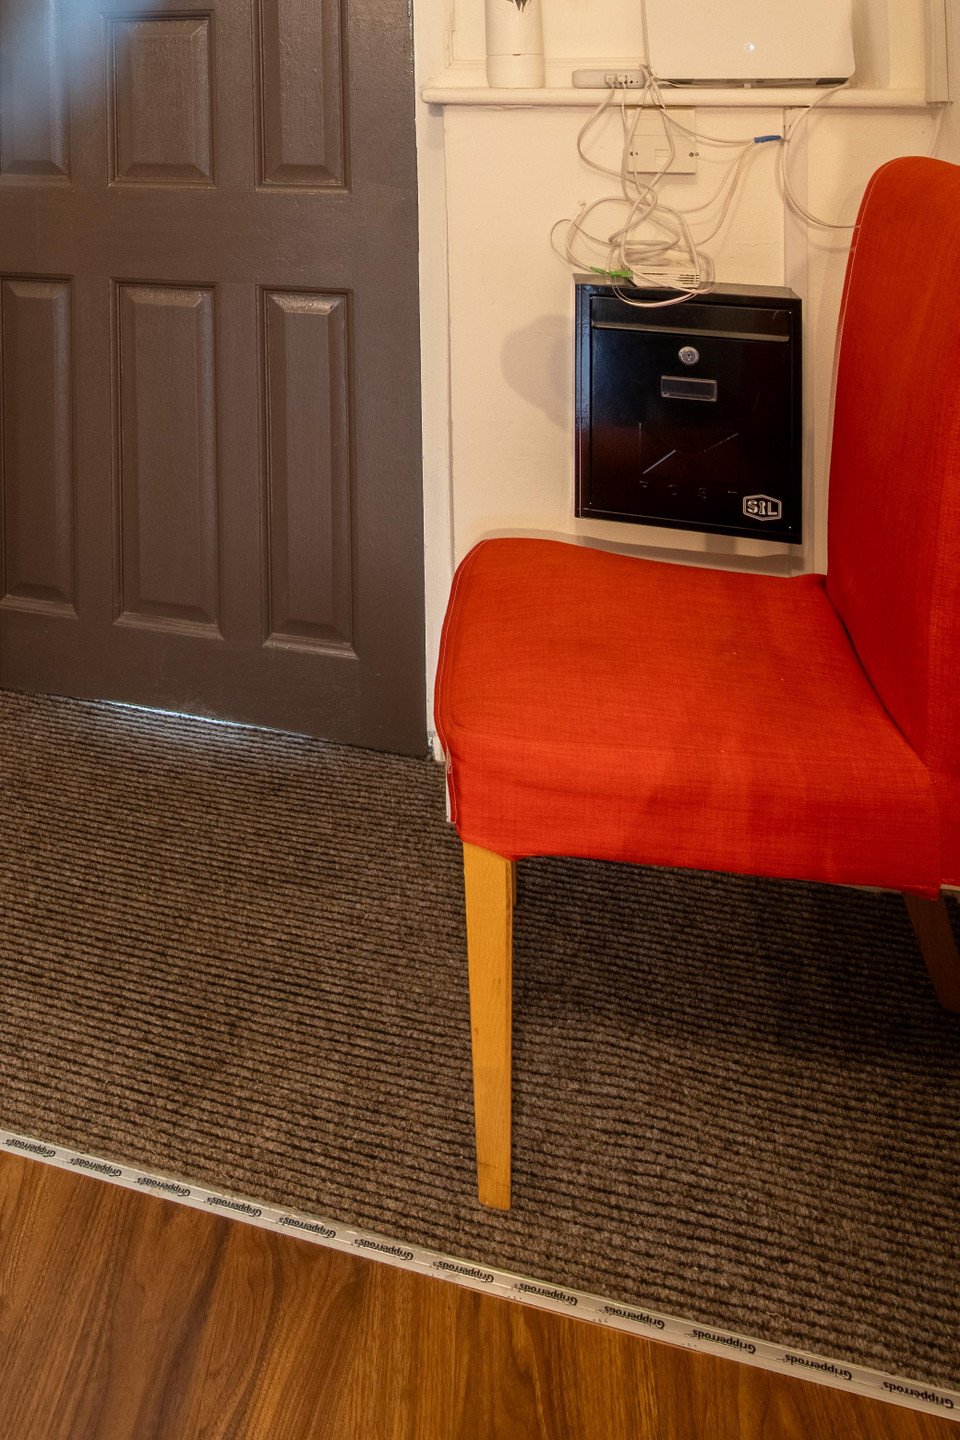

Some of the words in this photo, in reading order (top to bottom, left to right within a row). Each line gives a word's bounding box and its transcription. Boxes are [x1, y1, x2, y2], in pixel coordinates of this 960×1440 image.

[6, 1138, 56, 1158] Gripperrods
[70, 1157, 122, 1177] Gripperrods
[138, 1177, 191, 1197] Gripperrods
[207, 1196, 262, 1218] Gripperrods
[279, 1216, 336, 1239] Gripperrods
[355, 1238, 413, 1261] Gripperrods
[433, 1260, 494, 1283] Gripperrods
[519, 1282, 578, 1306] Gripperrods
[605, 1305, 665, 1330] Gripperrods
[693, 1328, 756, 1355] Gripperrods
[785, 1353, 852, 1381] Gripperrods
[883, 1380, 954, 1410] Gripperrods
